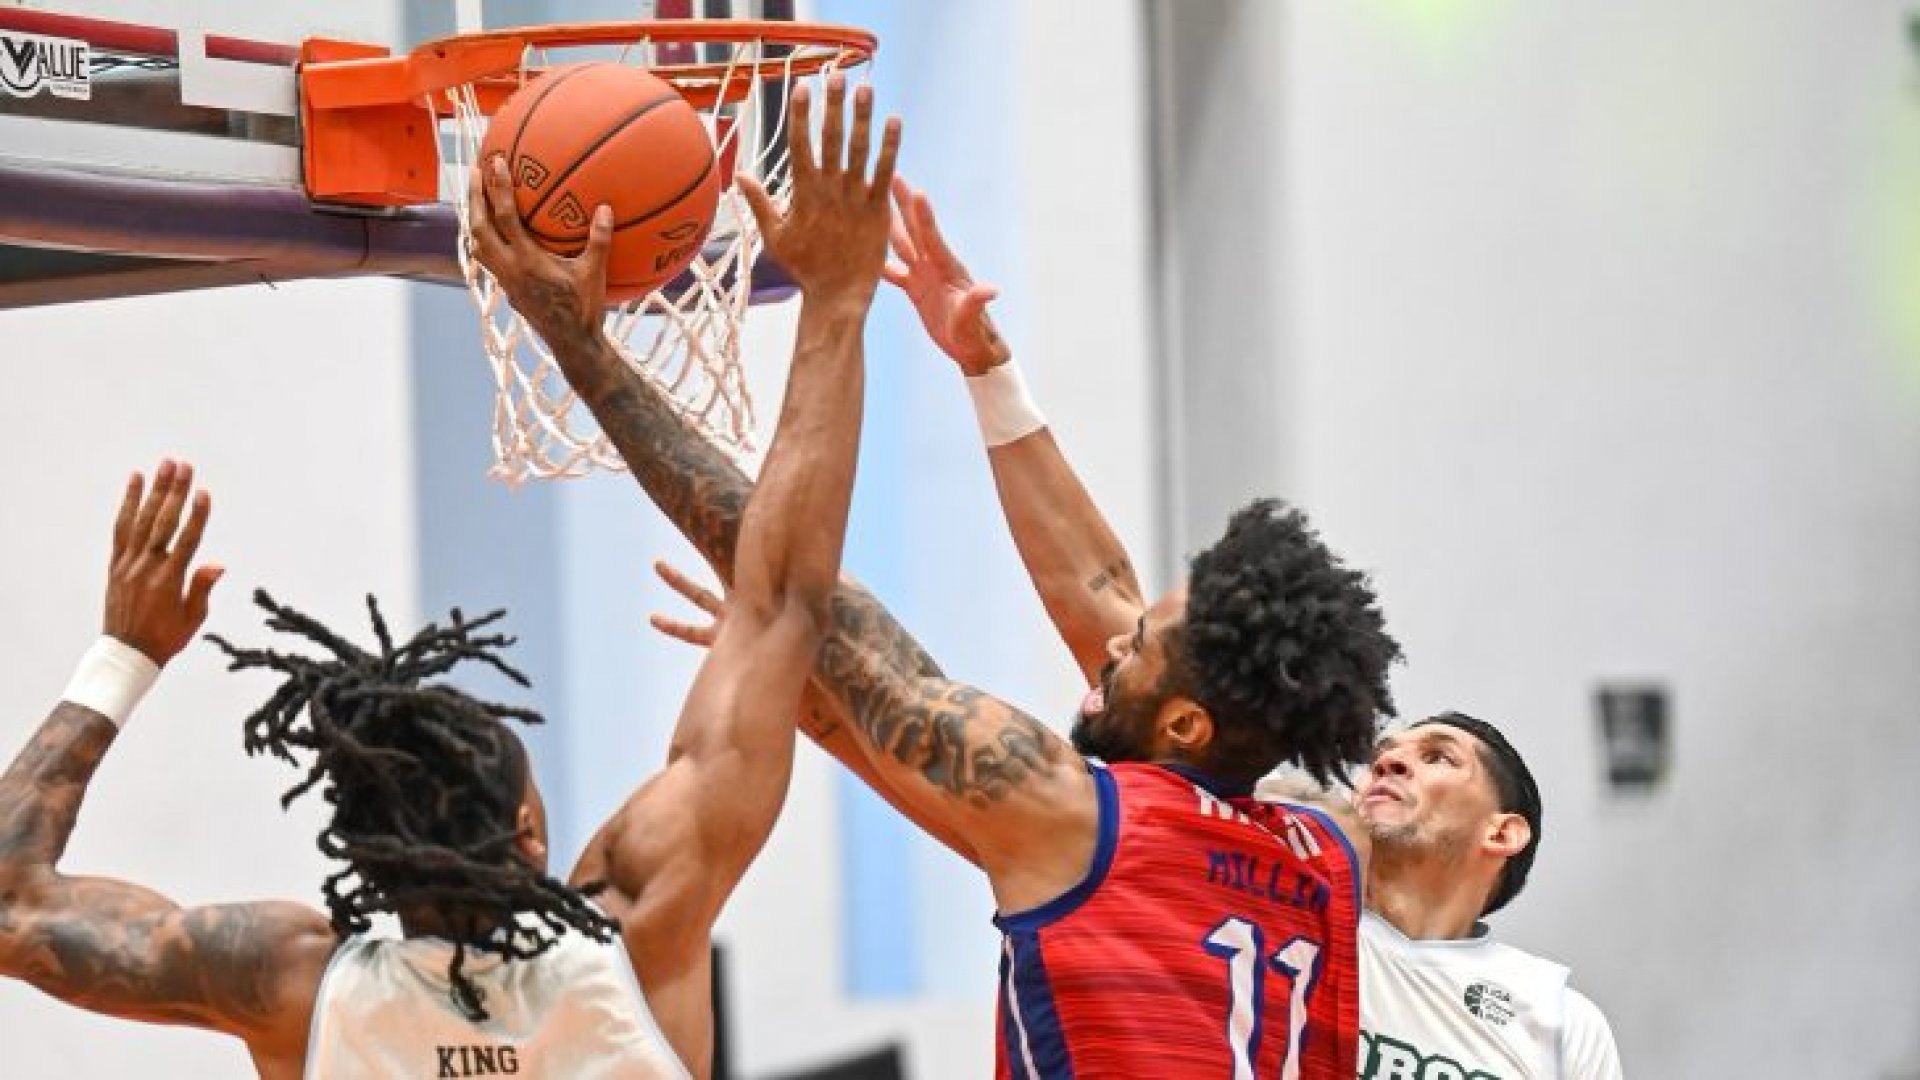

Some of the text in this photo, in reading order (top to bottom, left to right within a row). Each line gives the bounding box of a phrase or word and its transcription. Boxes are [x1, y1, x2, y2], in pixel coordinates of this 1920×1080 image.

[0, 36, 88, 80] VALUE
[1202, 914, 1325, 1080] 11
[436, 1045, 519, 1078] KING
